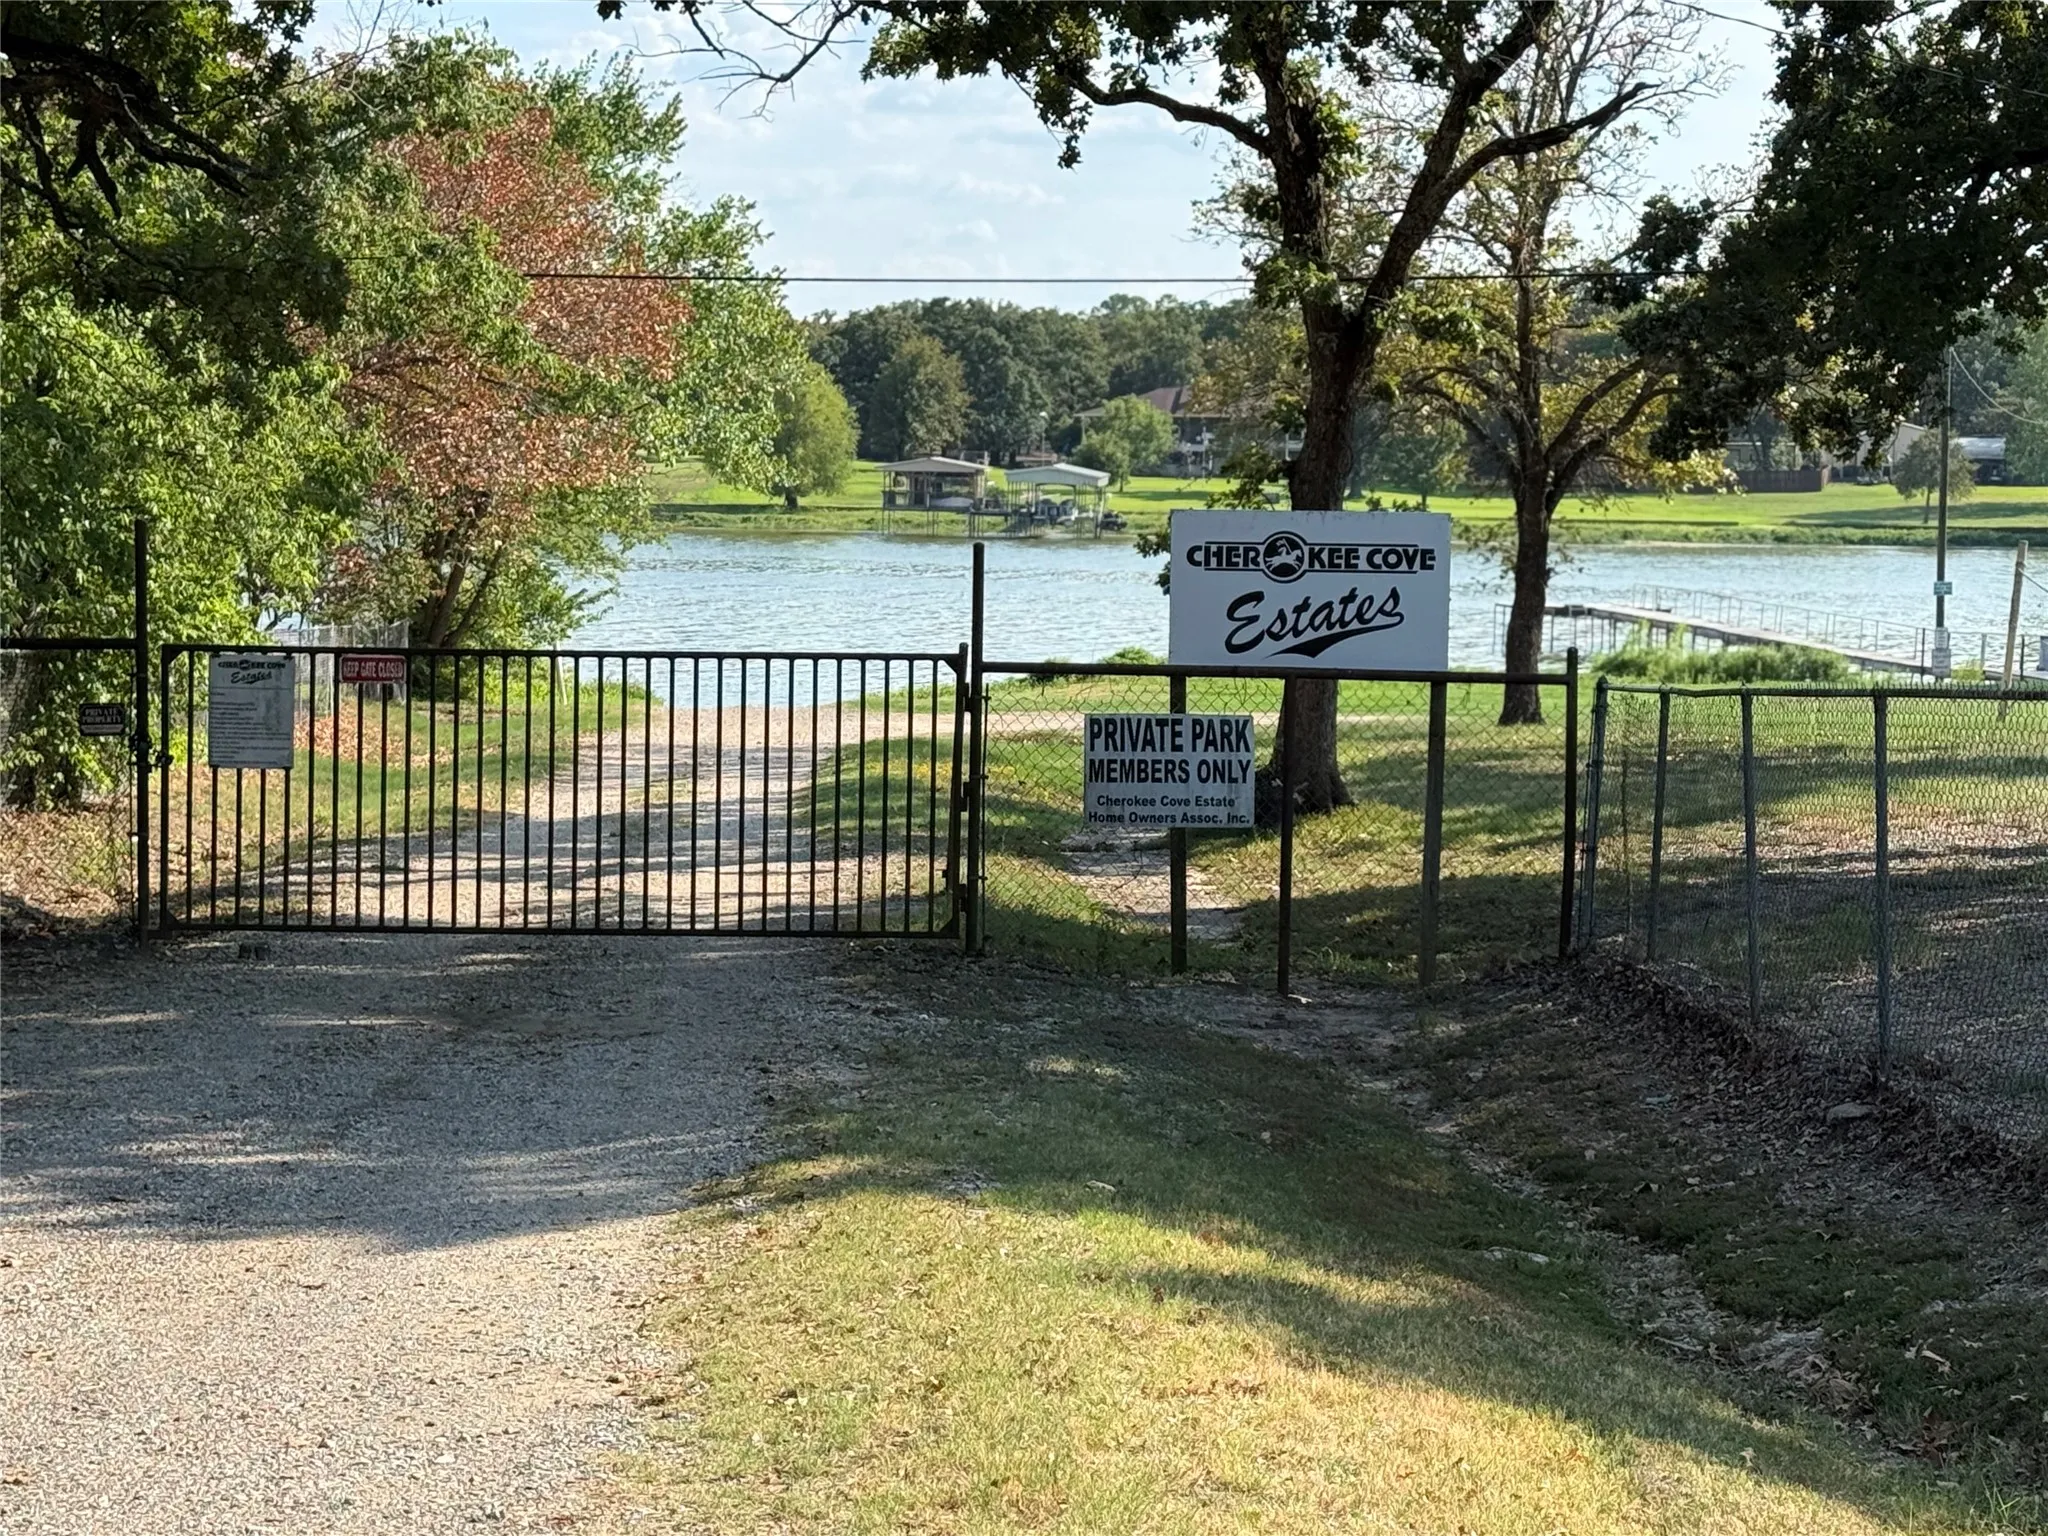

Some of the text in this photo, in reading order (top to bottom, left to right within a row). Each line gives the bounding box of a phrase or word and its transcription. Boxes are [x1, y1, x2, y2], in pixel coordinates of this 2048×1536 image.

[1366, 547, 1436, 571] COVE
[1225, 586, 1405, 656] Estates
[361, 662, 377, 677] GATE
[378, 662, 403, 678] CLOSED
[1089, 717, 1251, 753] PRIVATE PARK
[1088, 758, 1251, 784] MEMBERS ONLY
[1097, 795, 1236, 808] Cherokee Cove Estate
[1088, 811, 1250, 824] Home Owners Assoc. Inc.
